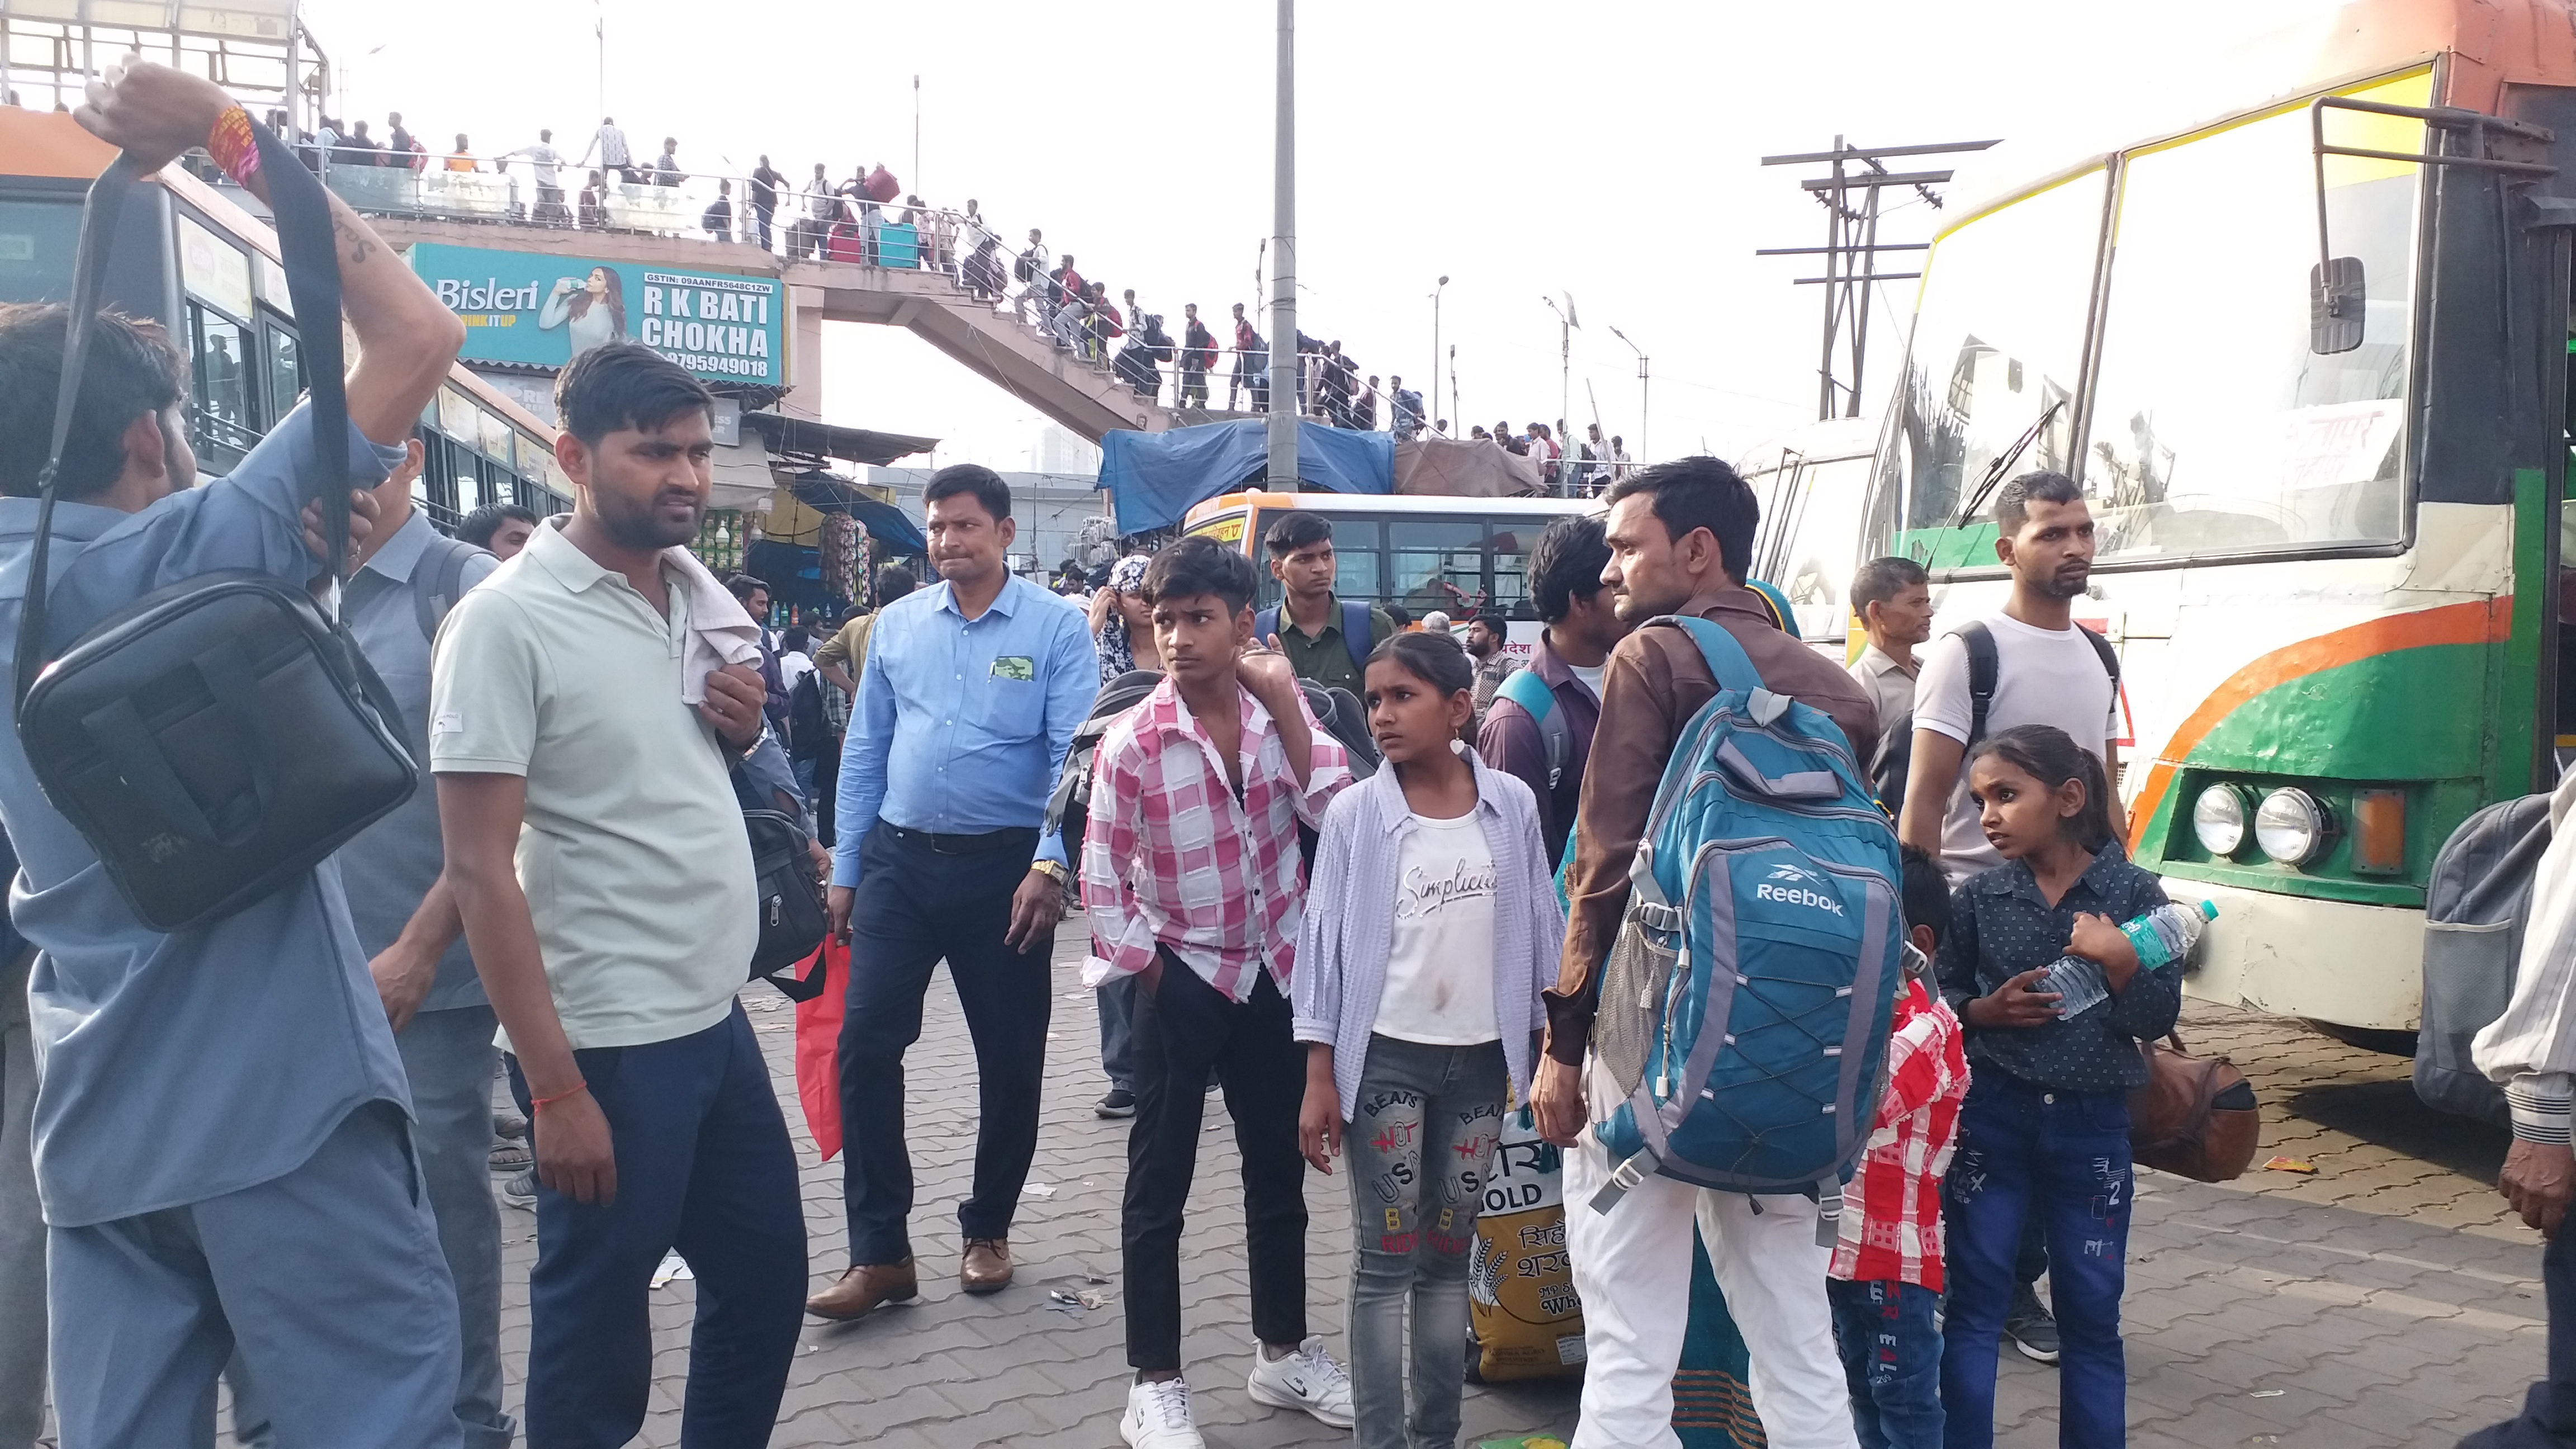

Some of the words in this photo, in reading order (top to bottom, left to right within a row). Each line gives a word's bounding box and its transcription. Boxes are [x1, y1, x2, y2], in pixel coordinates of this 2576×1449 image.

[437, 277, 538, 310] Bisleri
[647, 274, 679, 283] GSTIN:
[644, 286, 662, 315] R
[671, 288, 691, 317] K
[700, 290, 768, 324] BATI
[642, 318, 768, 358] CHOKHA
[1757, 884, 1844, 917] Reebok
[1363, 1091, 1418, 1117] BEATS
[1372, 1149, 1421, 1204] USA
[1481, 1183, 1542, 1212] OLD
[1539, 1285, 1558, 1298] MP
[1541, 1296, 1581, 1314] Whe
